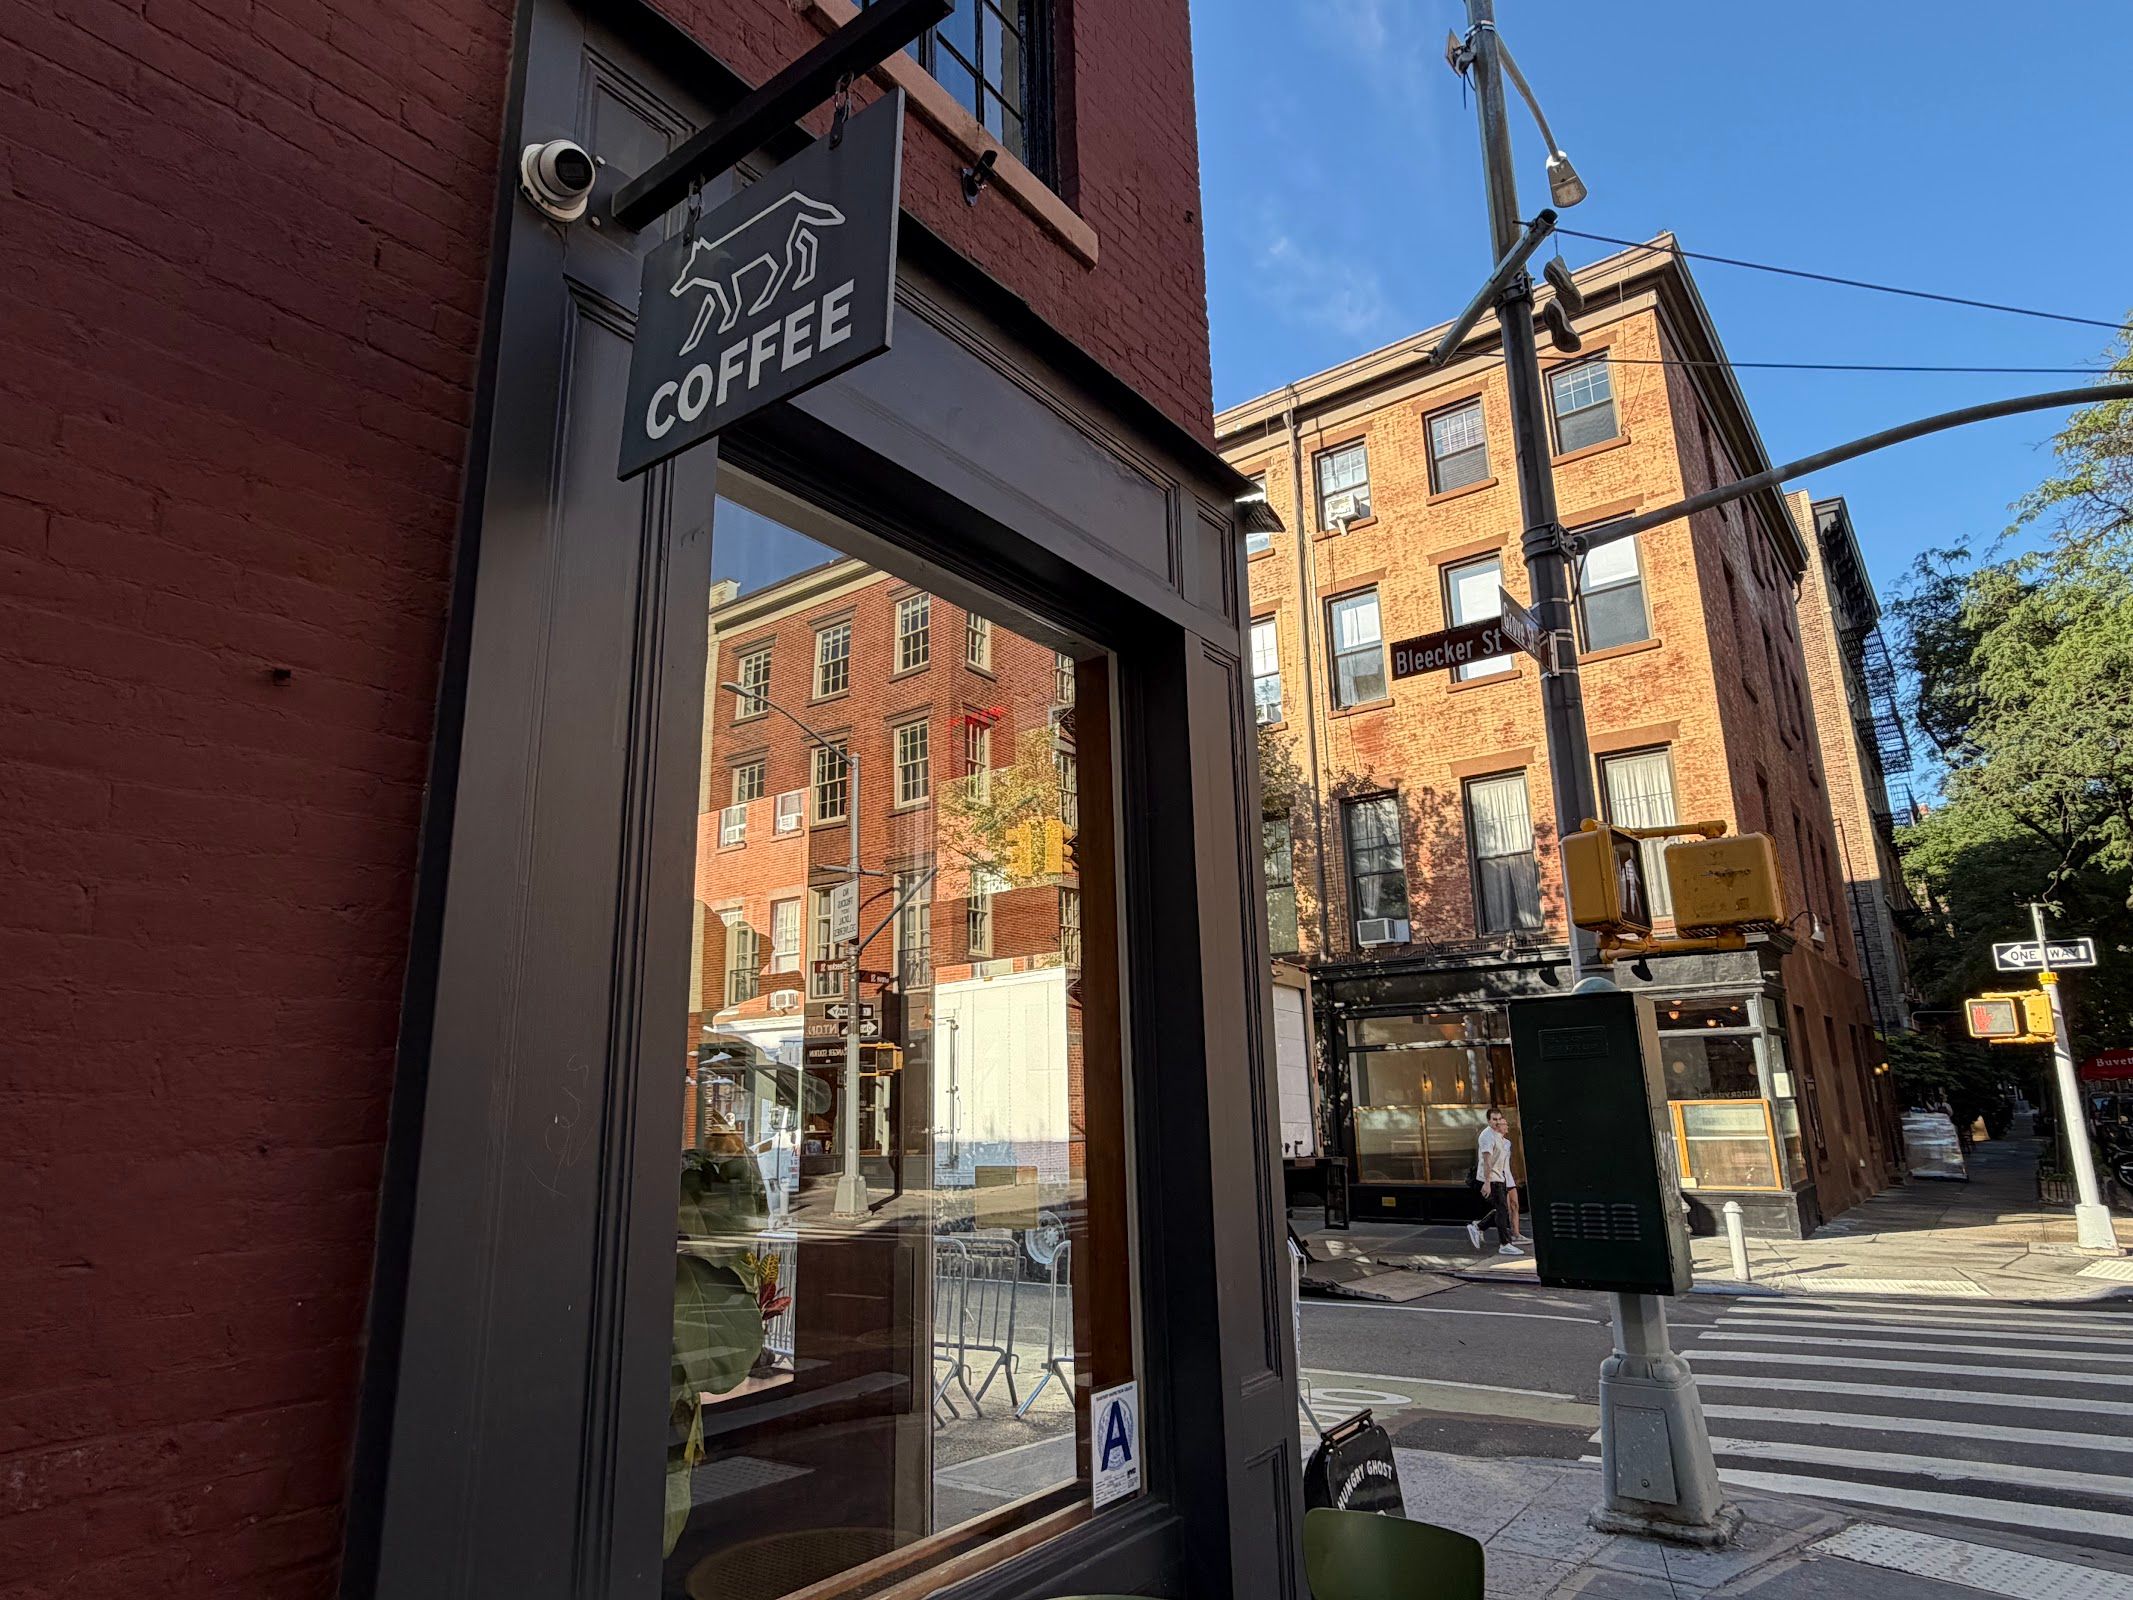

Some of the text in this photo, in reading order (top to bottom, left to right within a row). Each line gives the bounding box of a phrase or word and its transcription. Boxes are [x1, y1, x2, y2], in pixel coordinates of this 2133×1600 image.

[646, 278, 854, 440] COFFEE
[1395, 628, 1503, 676] Bleecker St
[2010, 947, 2078, 961] ONE WAY
[1101, 1399, 1132, 1473] A
[1337, 1459, 1393, 1511] HUNGRY GHOST
